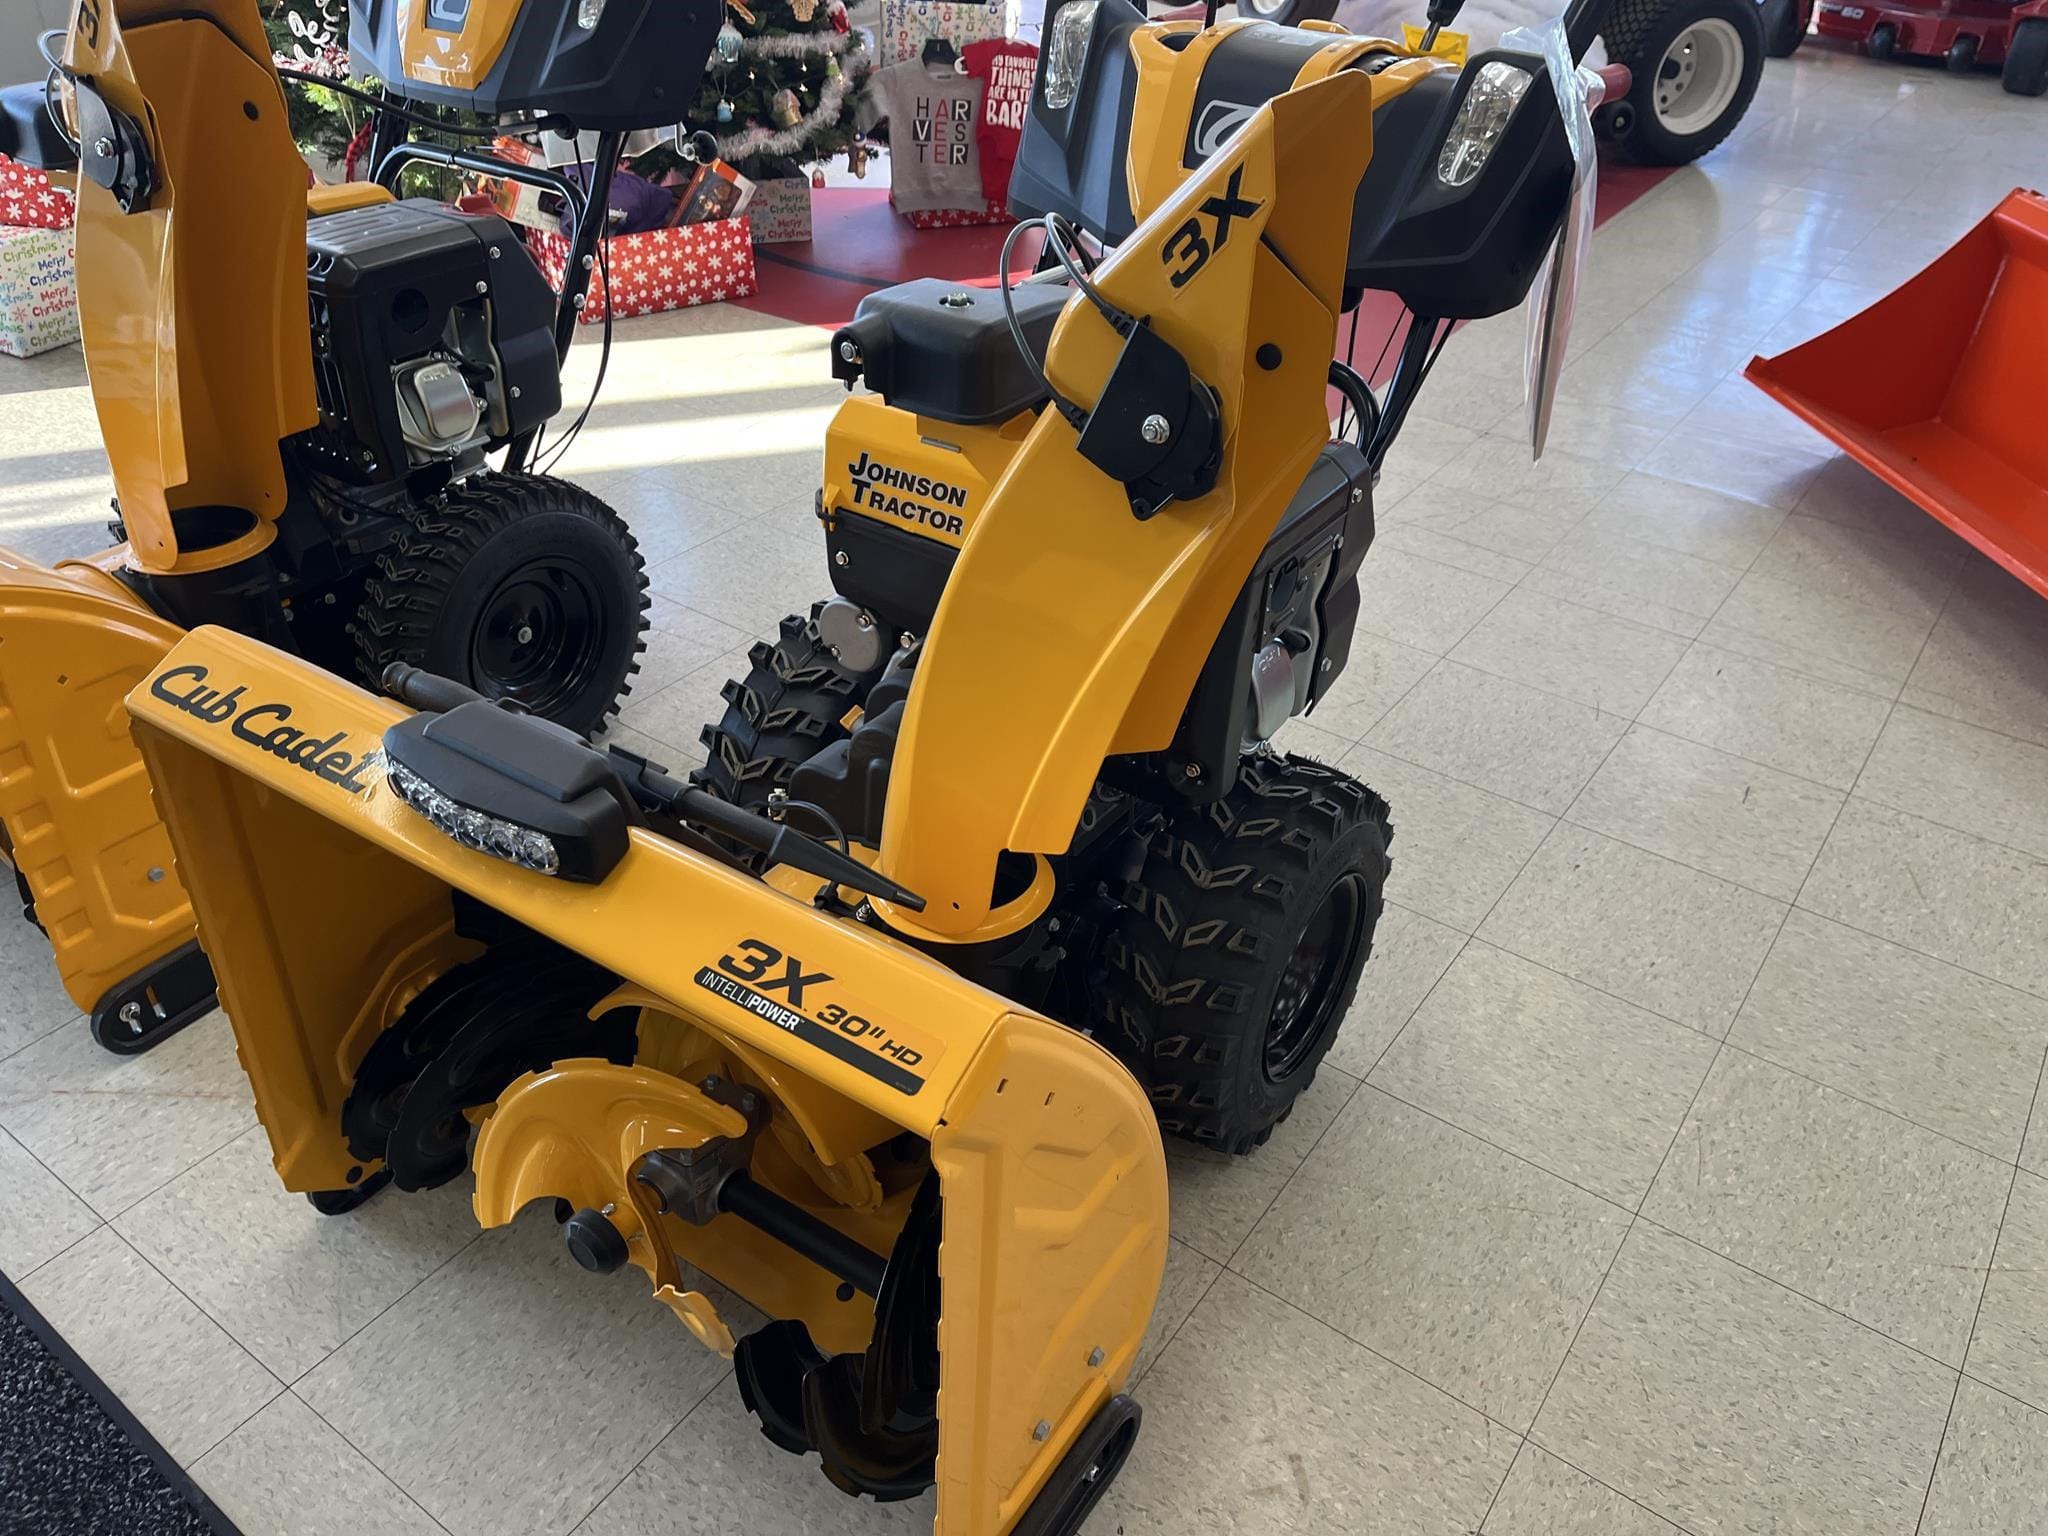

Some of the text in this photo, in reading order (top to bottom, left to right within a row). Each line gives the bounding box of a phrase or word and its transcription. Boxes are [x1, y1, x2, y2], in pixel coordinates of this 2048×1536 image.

[78, 0, 101, 49] 3
[1162, 161, 1265, 289] 3X
[38, 255, 66, 271] Merry
[40, 286, 69, 302] Merry
[38, 315, 66, 331] Merry
[848, 452, 967, 508] JOHNSON
[851, 477, 963, 536] TRACTOR
[150, 665, 372, 794] Cub Cadet
[718, 939, 835, 1010] 3X
[879, 1040, 923, 1066] HD
